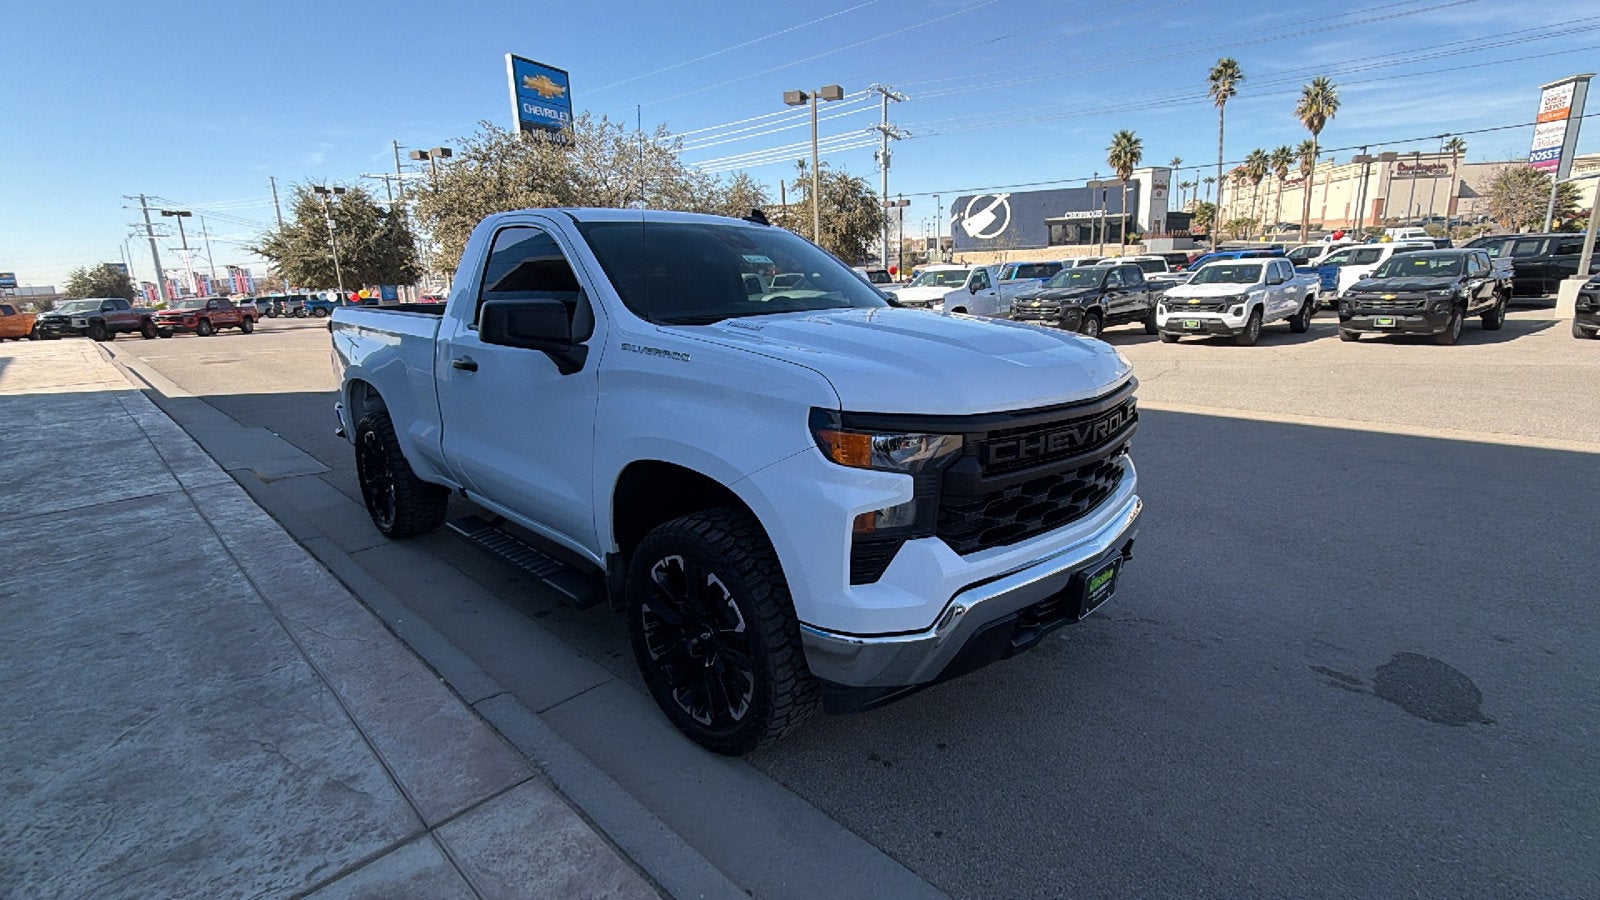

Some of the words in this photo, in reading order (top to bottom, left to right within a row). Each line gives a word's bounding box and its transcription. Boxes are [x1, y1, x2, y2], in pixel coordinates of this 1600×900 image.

[523, 103, 569, 122] CHEVROLET
[620, 342, 692, 362] SILVERADO
[989, 402, 1137, 464] CHEVROLE
